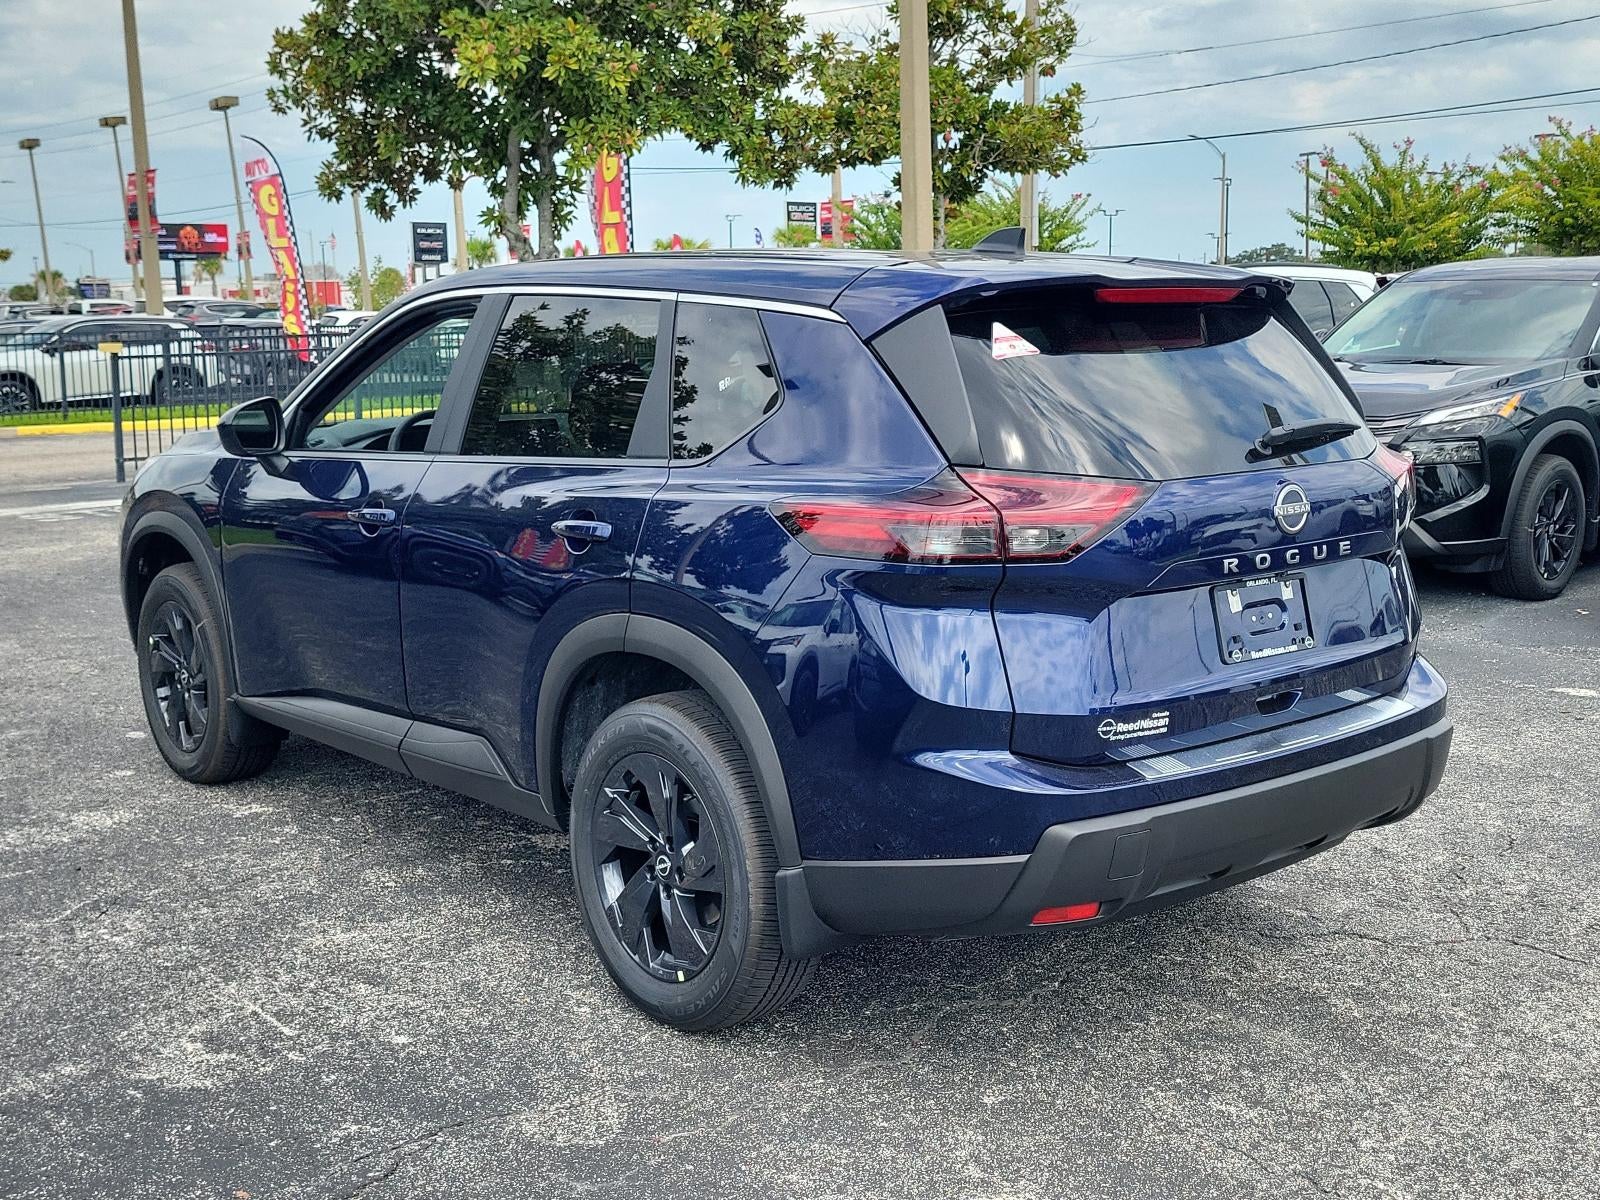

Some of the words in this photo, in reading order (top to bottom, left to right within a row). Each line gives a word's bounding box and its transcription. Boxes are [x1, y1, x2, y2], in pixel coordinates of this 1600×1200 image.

[790, 212, 816, 221] GMC
[1275, 502, 1310, 517] NISSAN
[1223, 541, 1352, 574] ROGUE
[1251, 645, 1298, 660] ReedNissan.com
